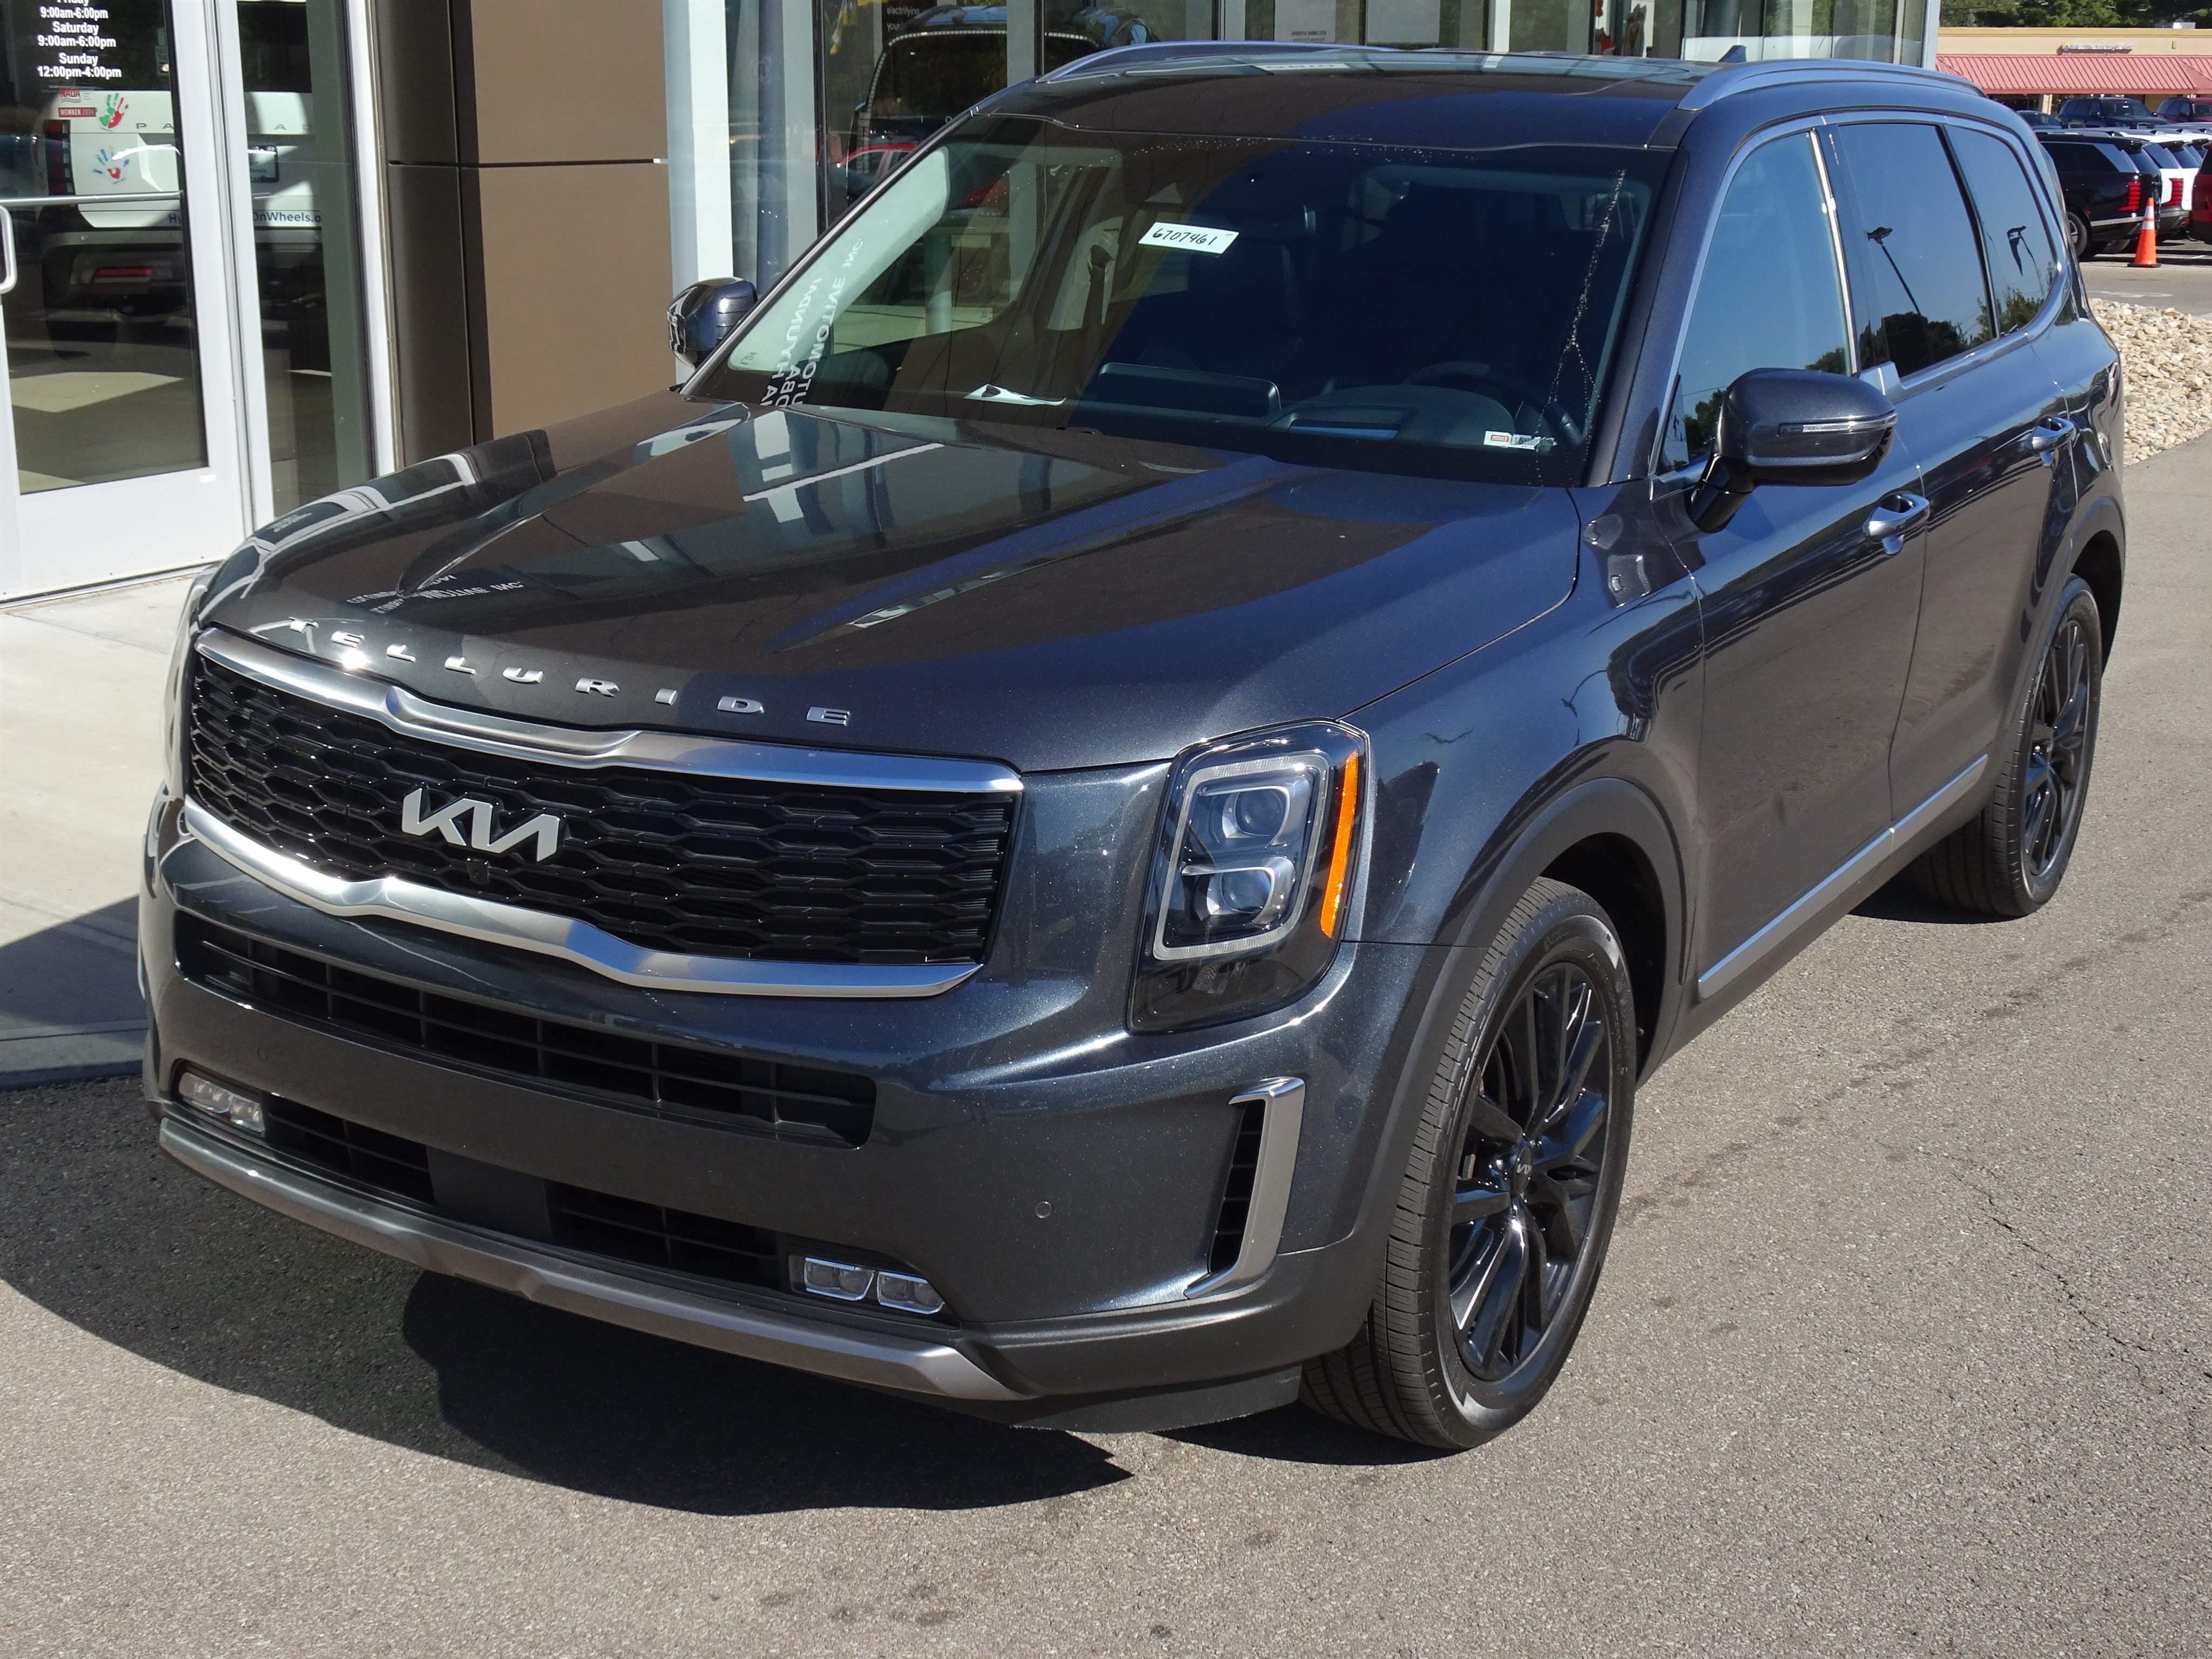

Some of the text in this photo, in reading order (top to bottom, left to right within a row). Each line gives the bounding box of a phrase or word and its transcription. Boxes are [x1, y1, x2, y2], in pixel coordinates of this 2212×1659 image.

[39, 6, 109, 21] 9:00am-6:00pm
[52, 21, 99, 36] Saturday
[37, 35, 117, 49] 9:00am-6:00pm
[59, 52, 99, 66] Sunday
[37, 65, 122, 79] 12:00pm-4:00pm
[1152, 228, 1218, 246] 6707461
[288, 616, 852, 727] TELLURIDE
[401, 786, 562, 862] KIA
